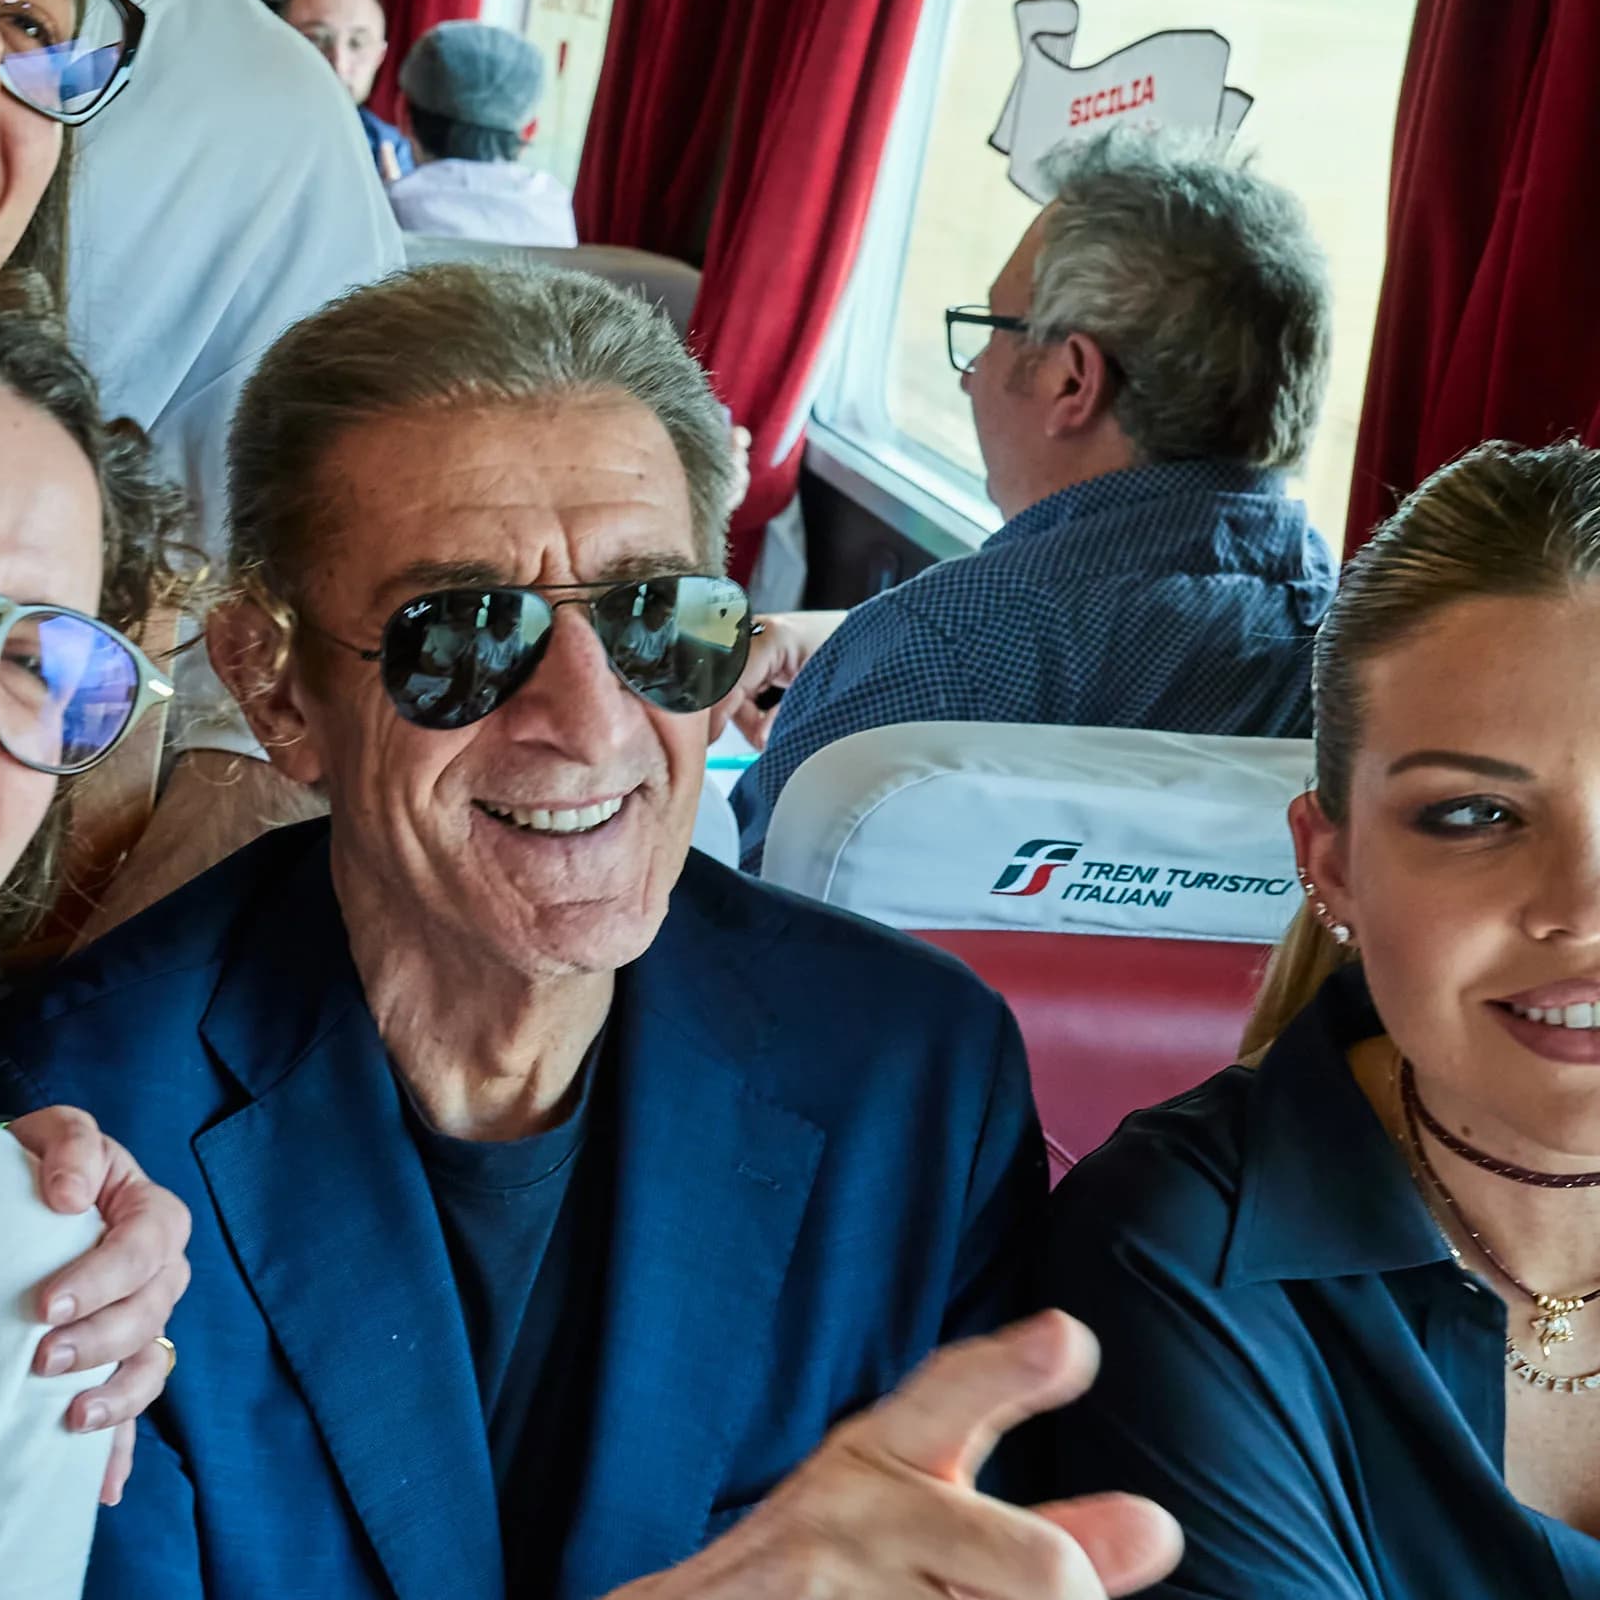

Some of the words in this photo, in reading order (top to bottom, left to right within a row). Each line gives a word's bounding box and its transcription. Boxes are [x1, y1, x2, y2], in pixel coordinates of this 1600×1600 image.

[1069, 74, 1155, 127] SICILIA
[1060, 882, 1173, 908] ITALIANI
[1082, 861, 1160, 884] TRENI
[1166, 867, 1294, 896] TURISTICI
